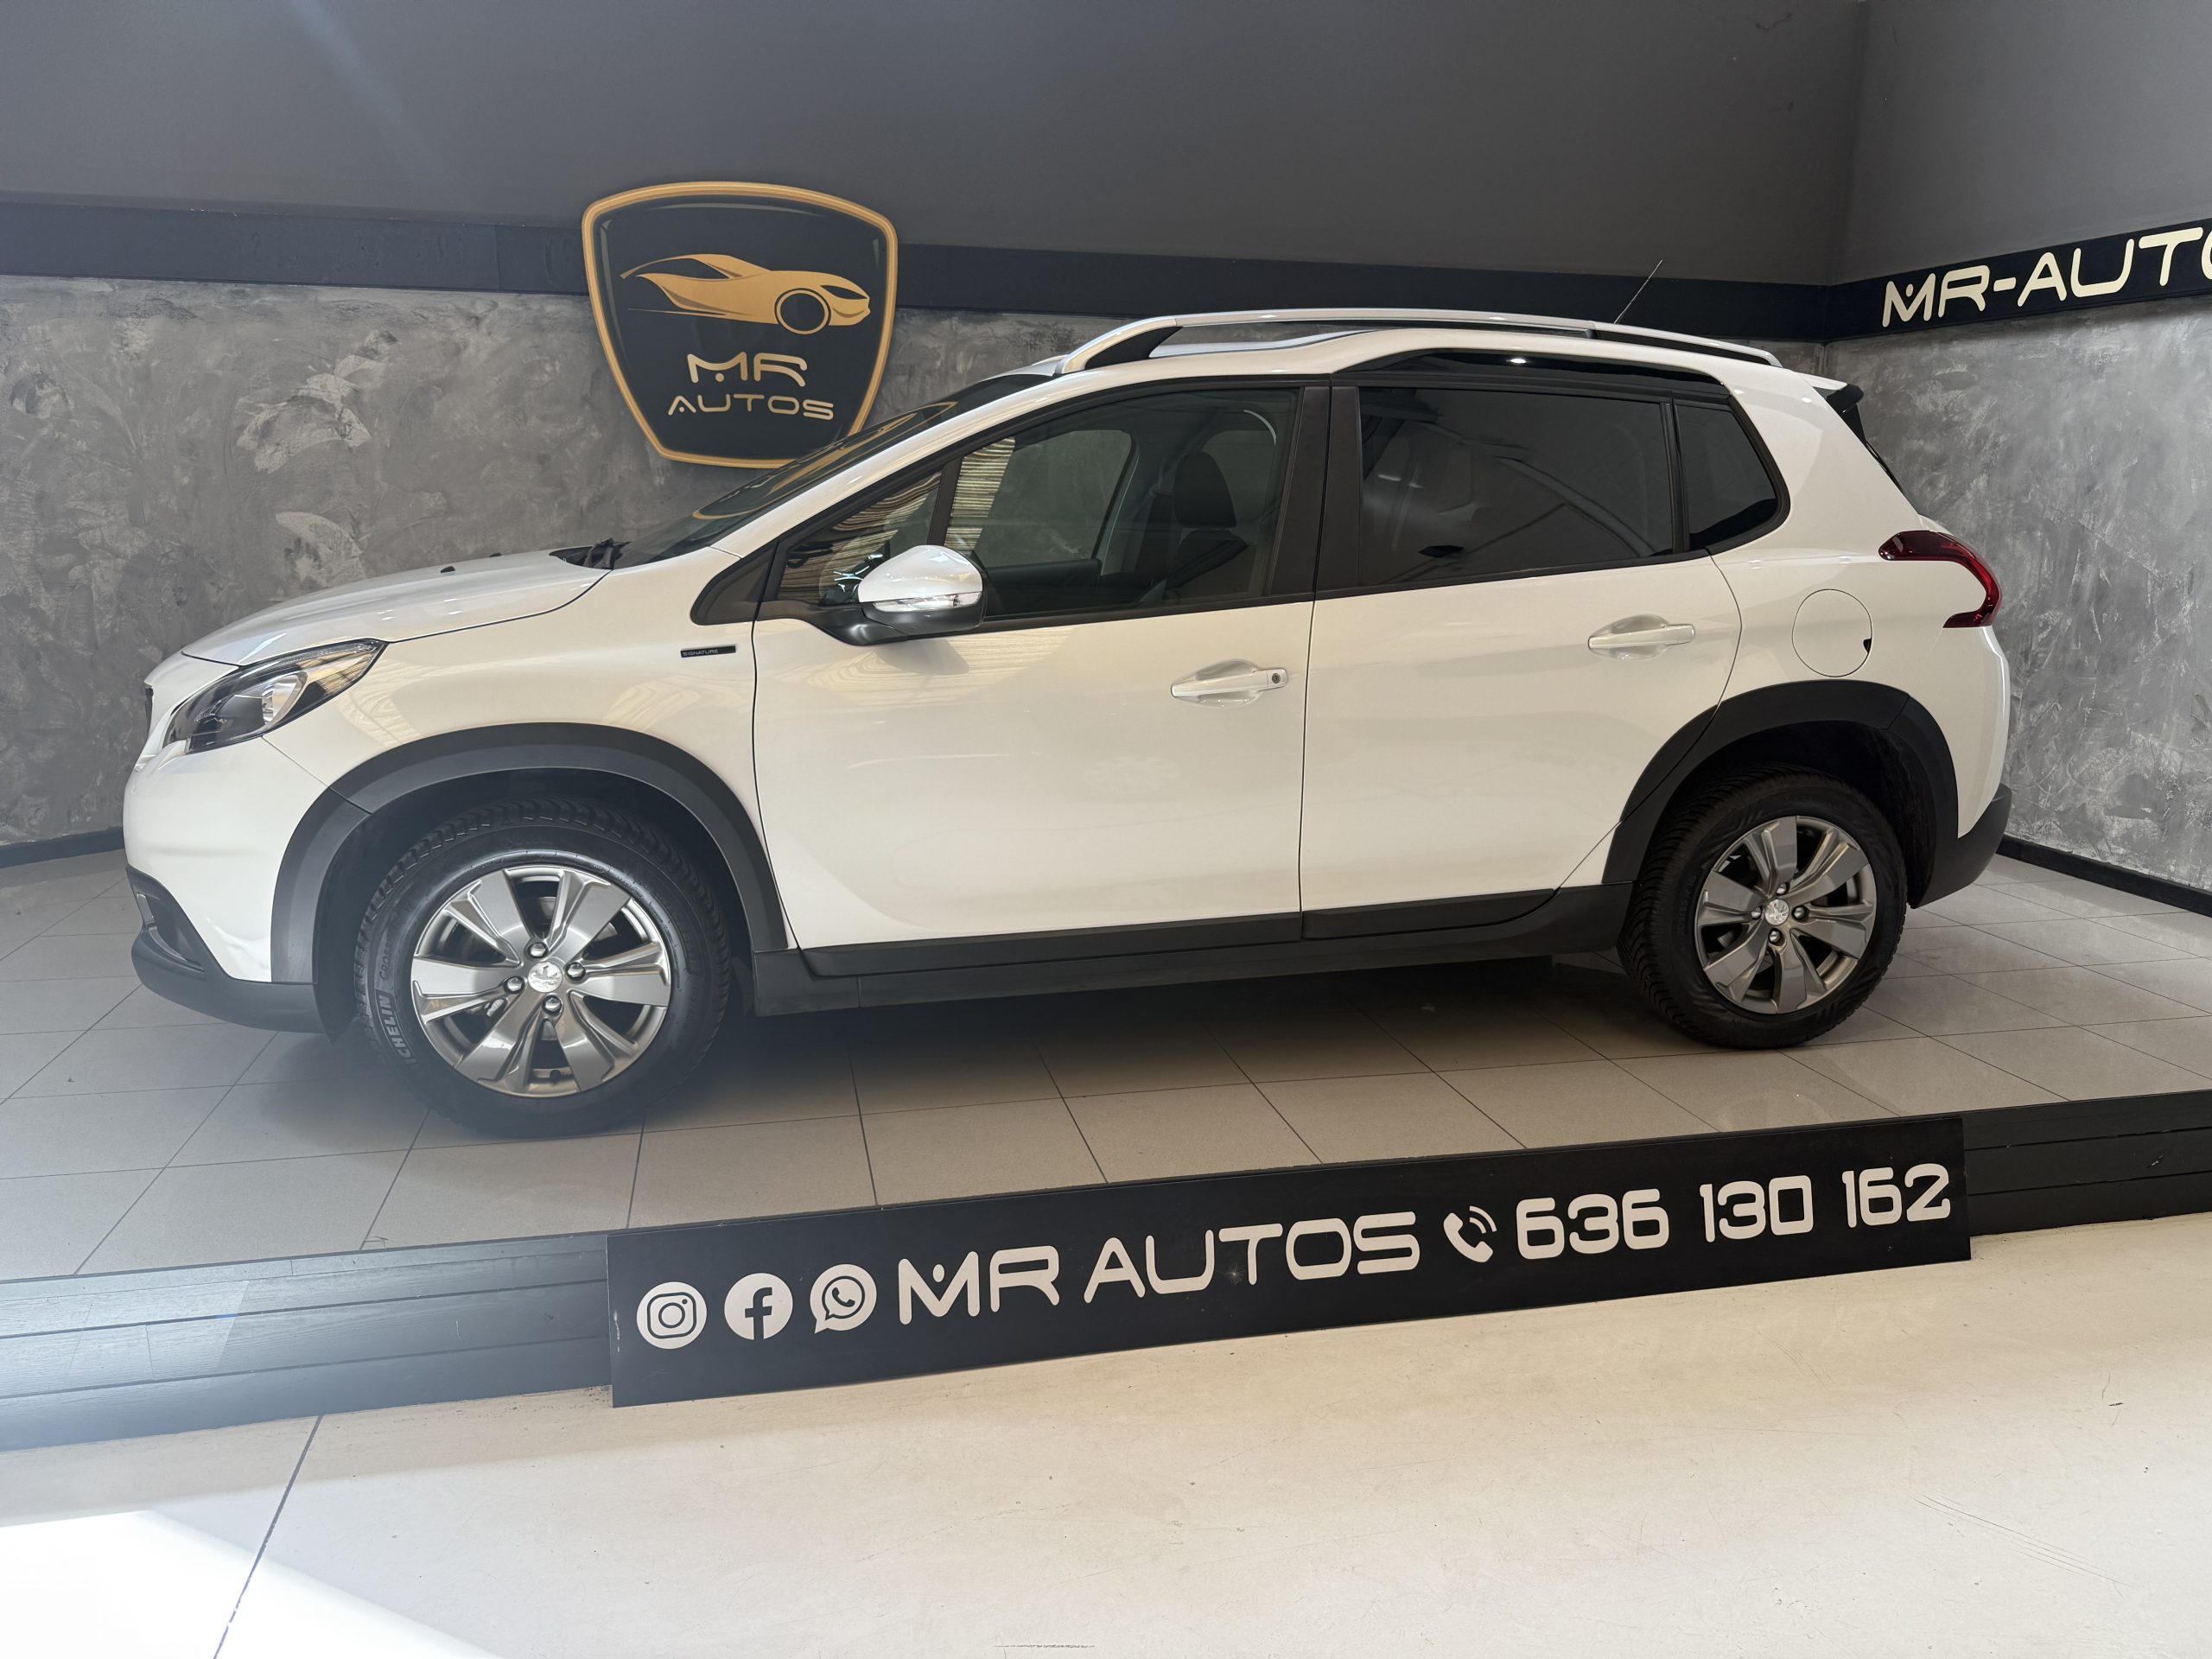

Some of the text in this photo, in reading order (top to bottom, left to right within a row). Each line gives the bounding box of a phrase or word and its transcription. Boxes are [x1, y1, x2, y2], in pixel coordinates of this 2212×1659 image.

[1882, 226, 2212, 327] MR-AUT
[668, 393, 834, 421] AUTOS
[687, 351, 808, 387] MR
[378, 995, 420, 1071] ICHELIN
[899, 1163, 1951, 1325] MR AUTOS 636 130 162
